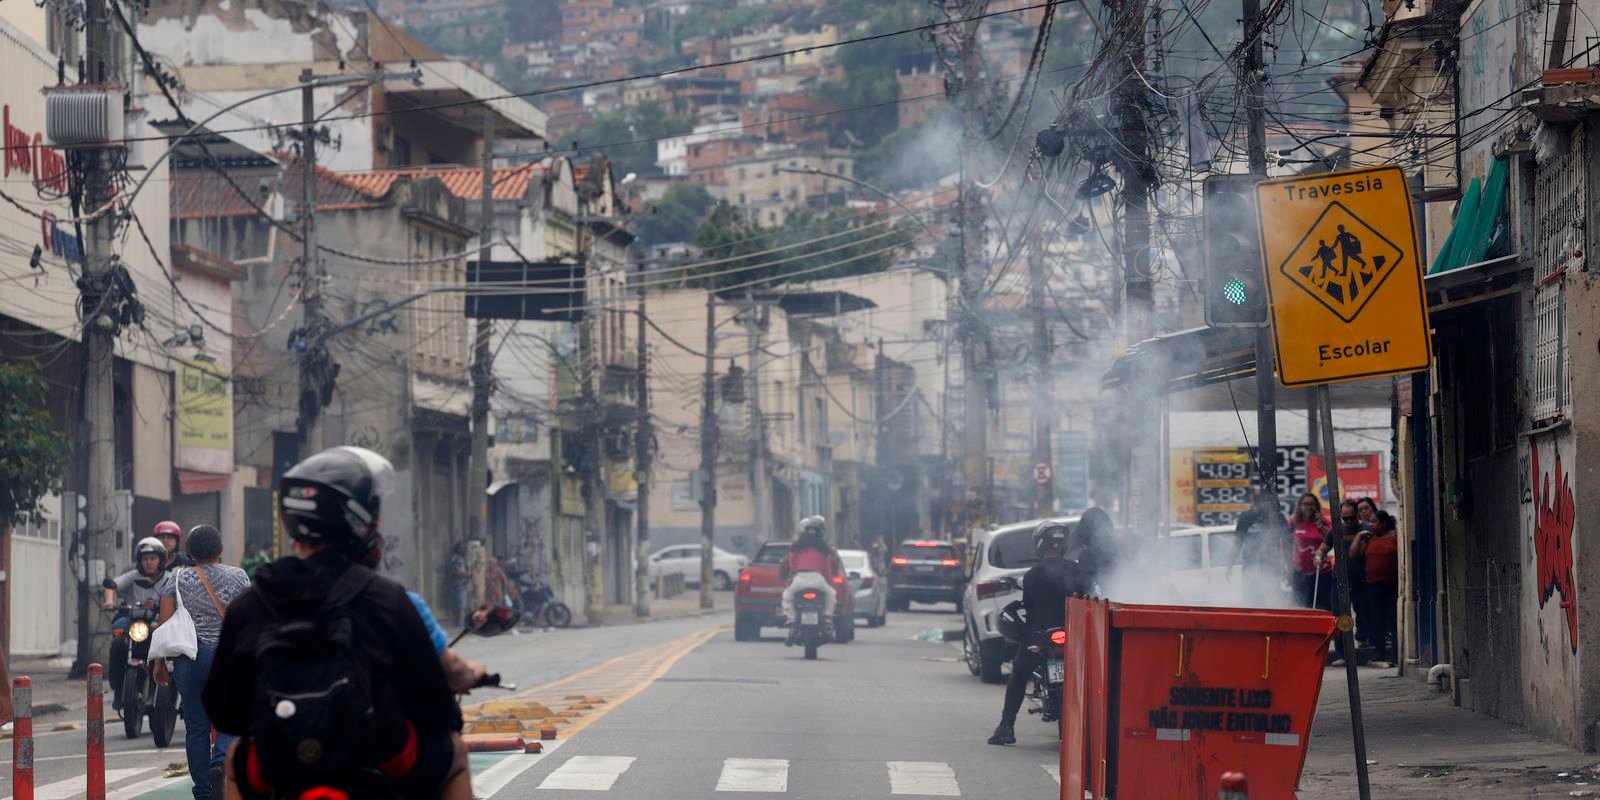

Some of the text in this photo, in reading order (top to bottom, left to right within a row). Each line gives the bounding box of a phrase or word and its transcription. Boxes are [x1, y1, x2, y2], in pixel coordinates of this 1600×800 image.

[1284, 176, 1383, 200] Travessia
[1318, 338, 1391, 362] Escolar
[1199, 462, 1246, 479] 4.09
[1199, 487, 1247, 503] 5.82
[1170, 687, 1272, 708] SOMENTE LIXO
[1149, 706, 1291, 733] NÃO JOGUE ENTULHO
